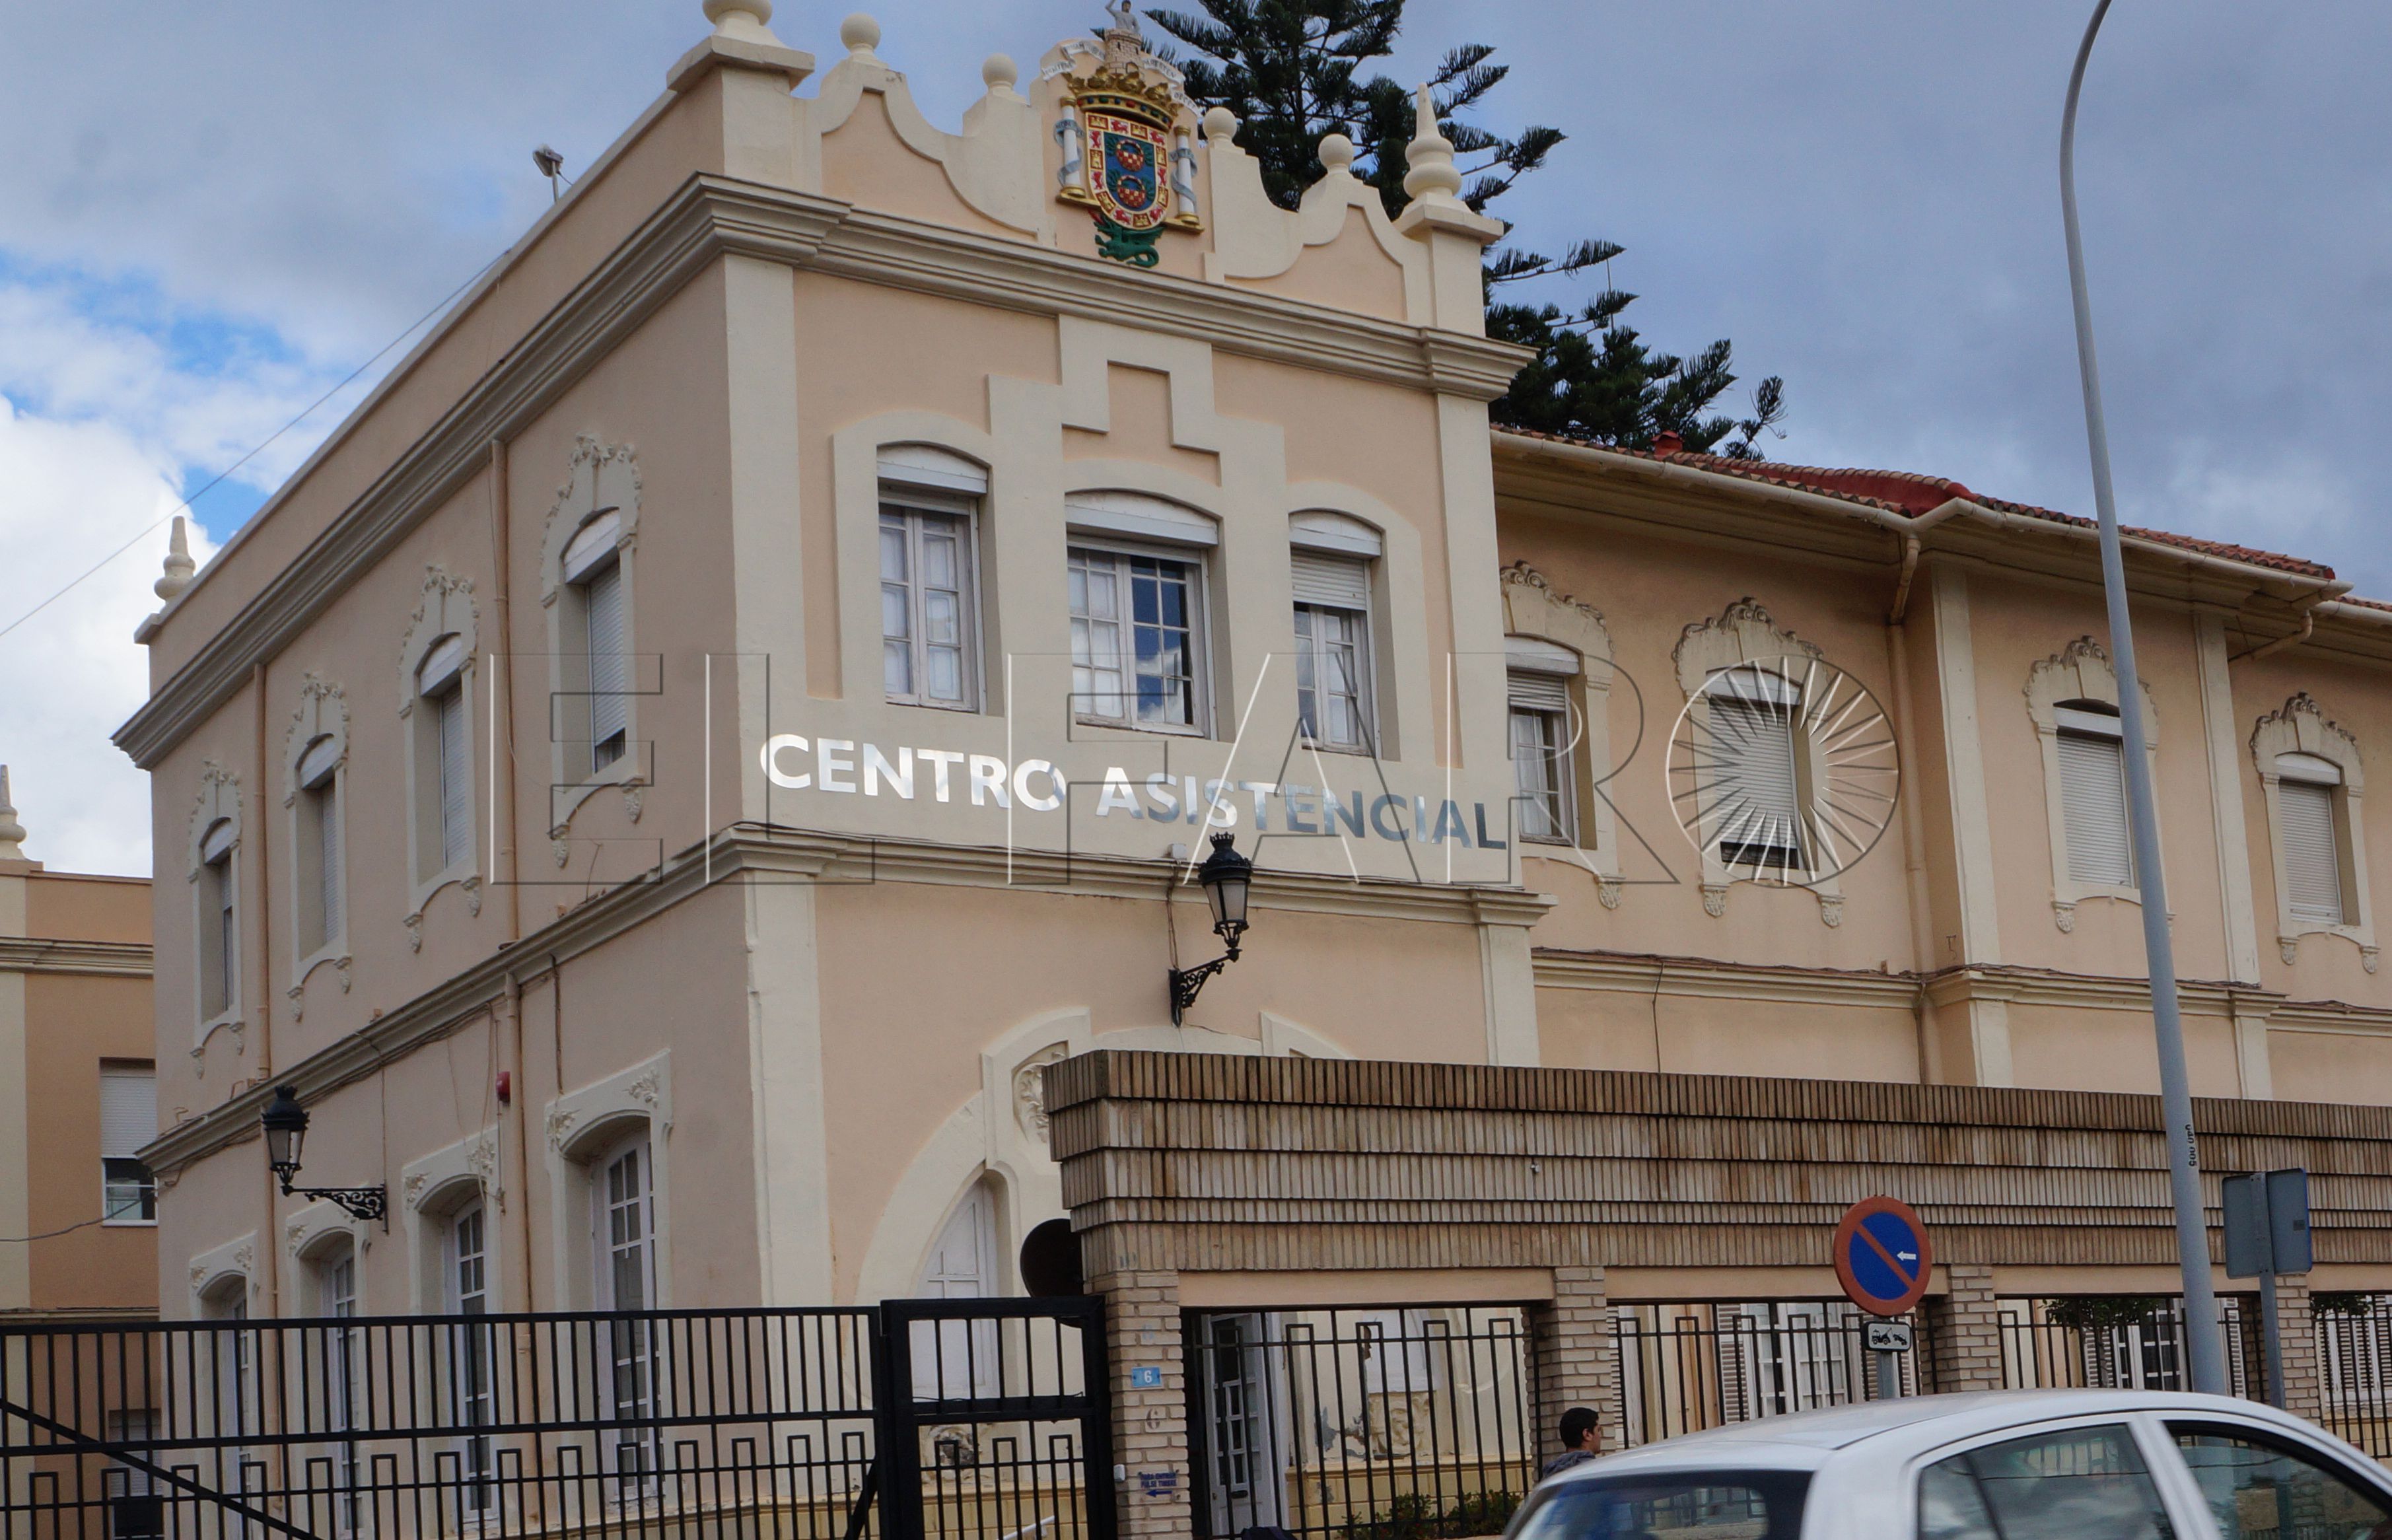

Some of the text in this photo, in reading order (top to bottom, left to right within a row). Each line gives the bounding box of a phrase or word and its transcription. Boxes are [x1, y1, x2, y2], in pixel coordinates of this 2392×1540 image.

[759, 733, 1507, 851] CENTRO ASISTENCIAL
[1144, 1370, 1152, 1383] 6
